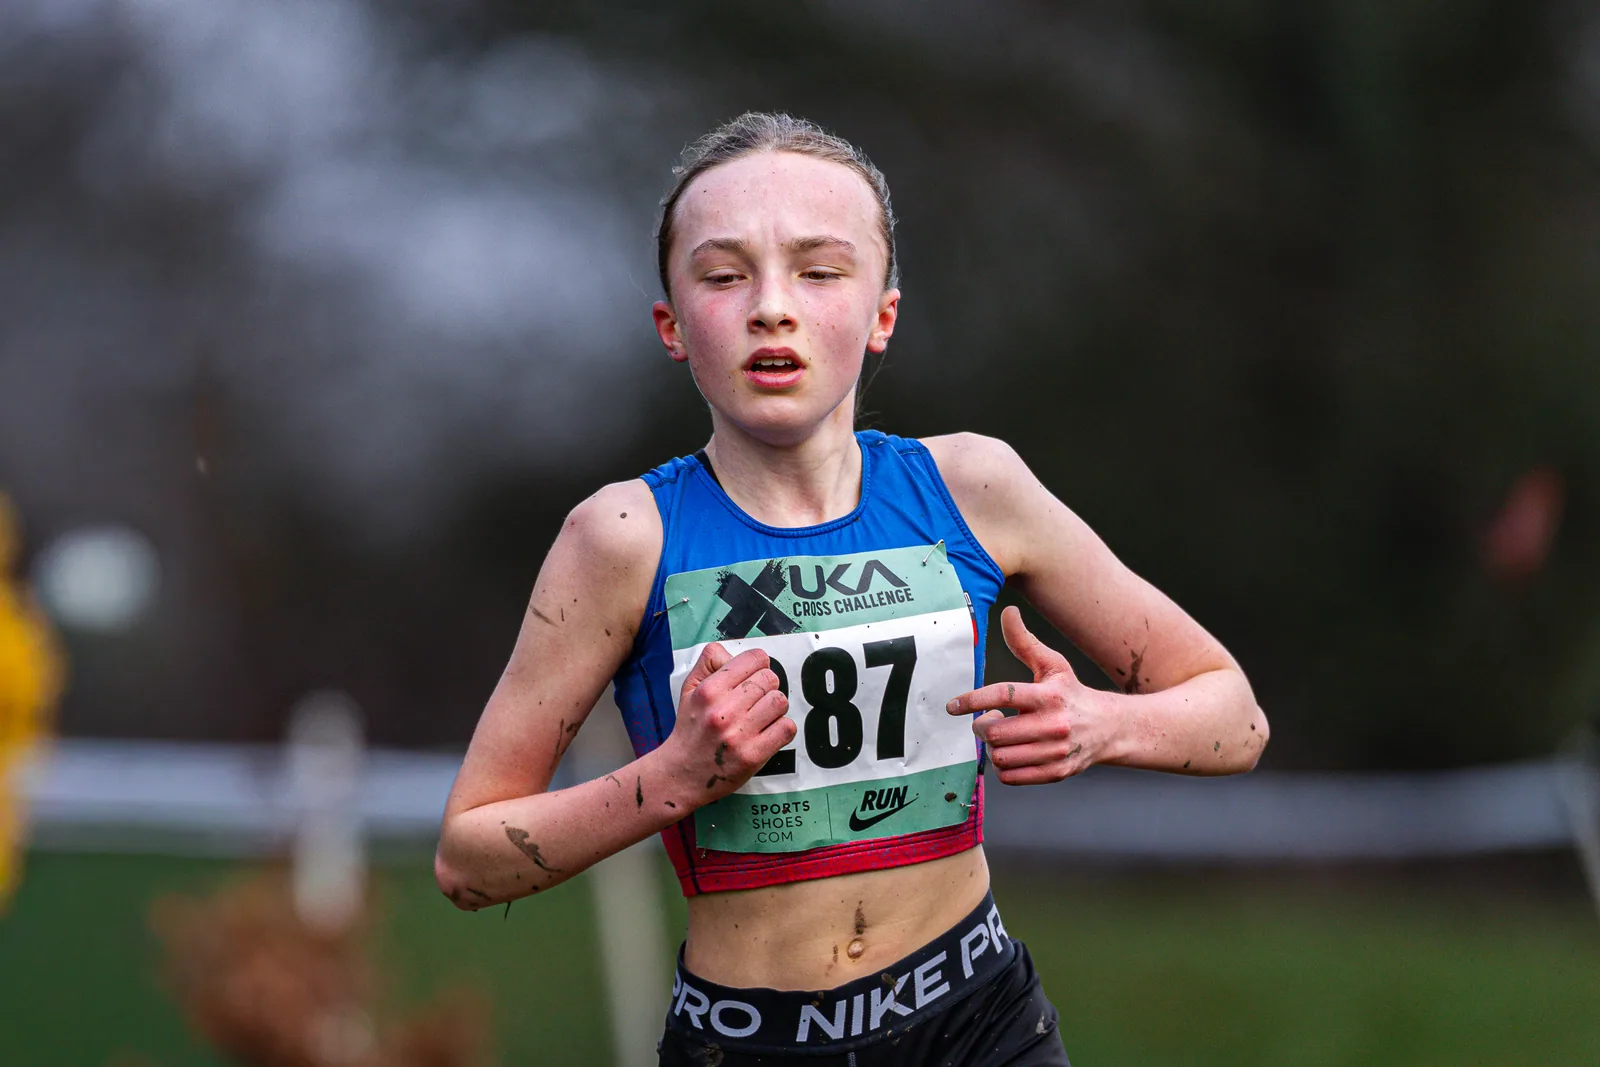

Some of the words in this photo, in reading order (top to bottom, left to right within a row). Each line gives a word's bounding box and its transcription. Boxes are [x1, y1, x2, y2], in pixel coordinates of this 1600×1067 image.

[789, 559, 909, 600] UKA
[793, 601, 832, 617] CROSS
[835, 587, 914, 614] CHALLENGE
[751, 801, 810, 816] SPORTS
[860, 785, 908, 812] RUN
[752, 815, 803, 830] SHOES
[754, 831, 793, 844] .COM
[796, 951, 950, 1042] NIKE
